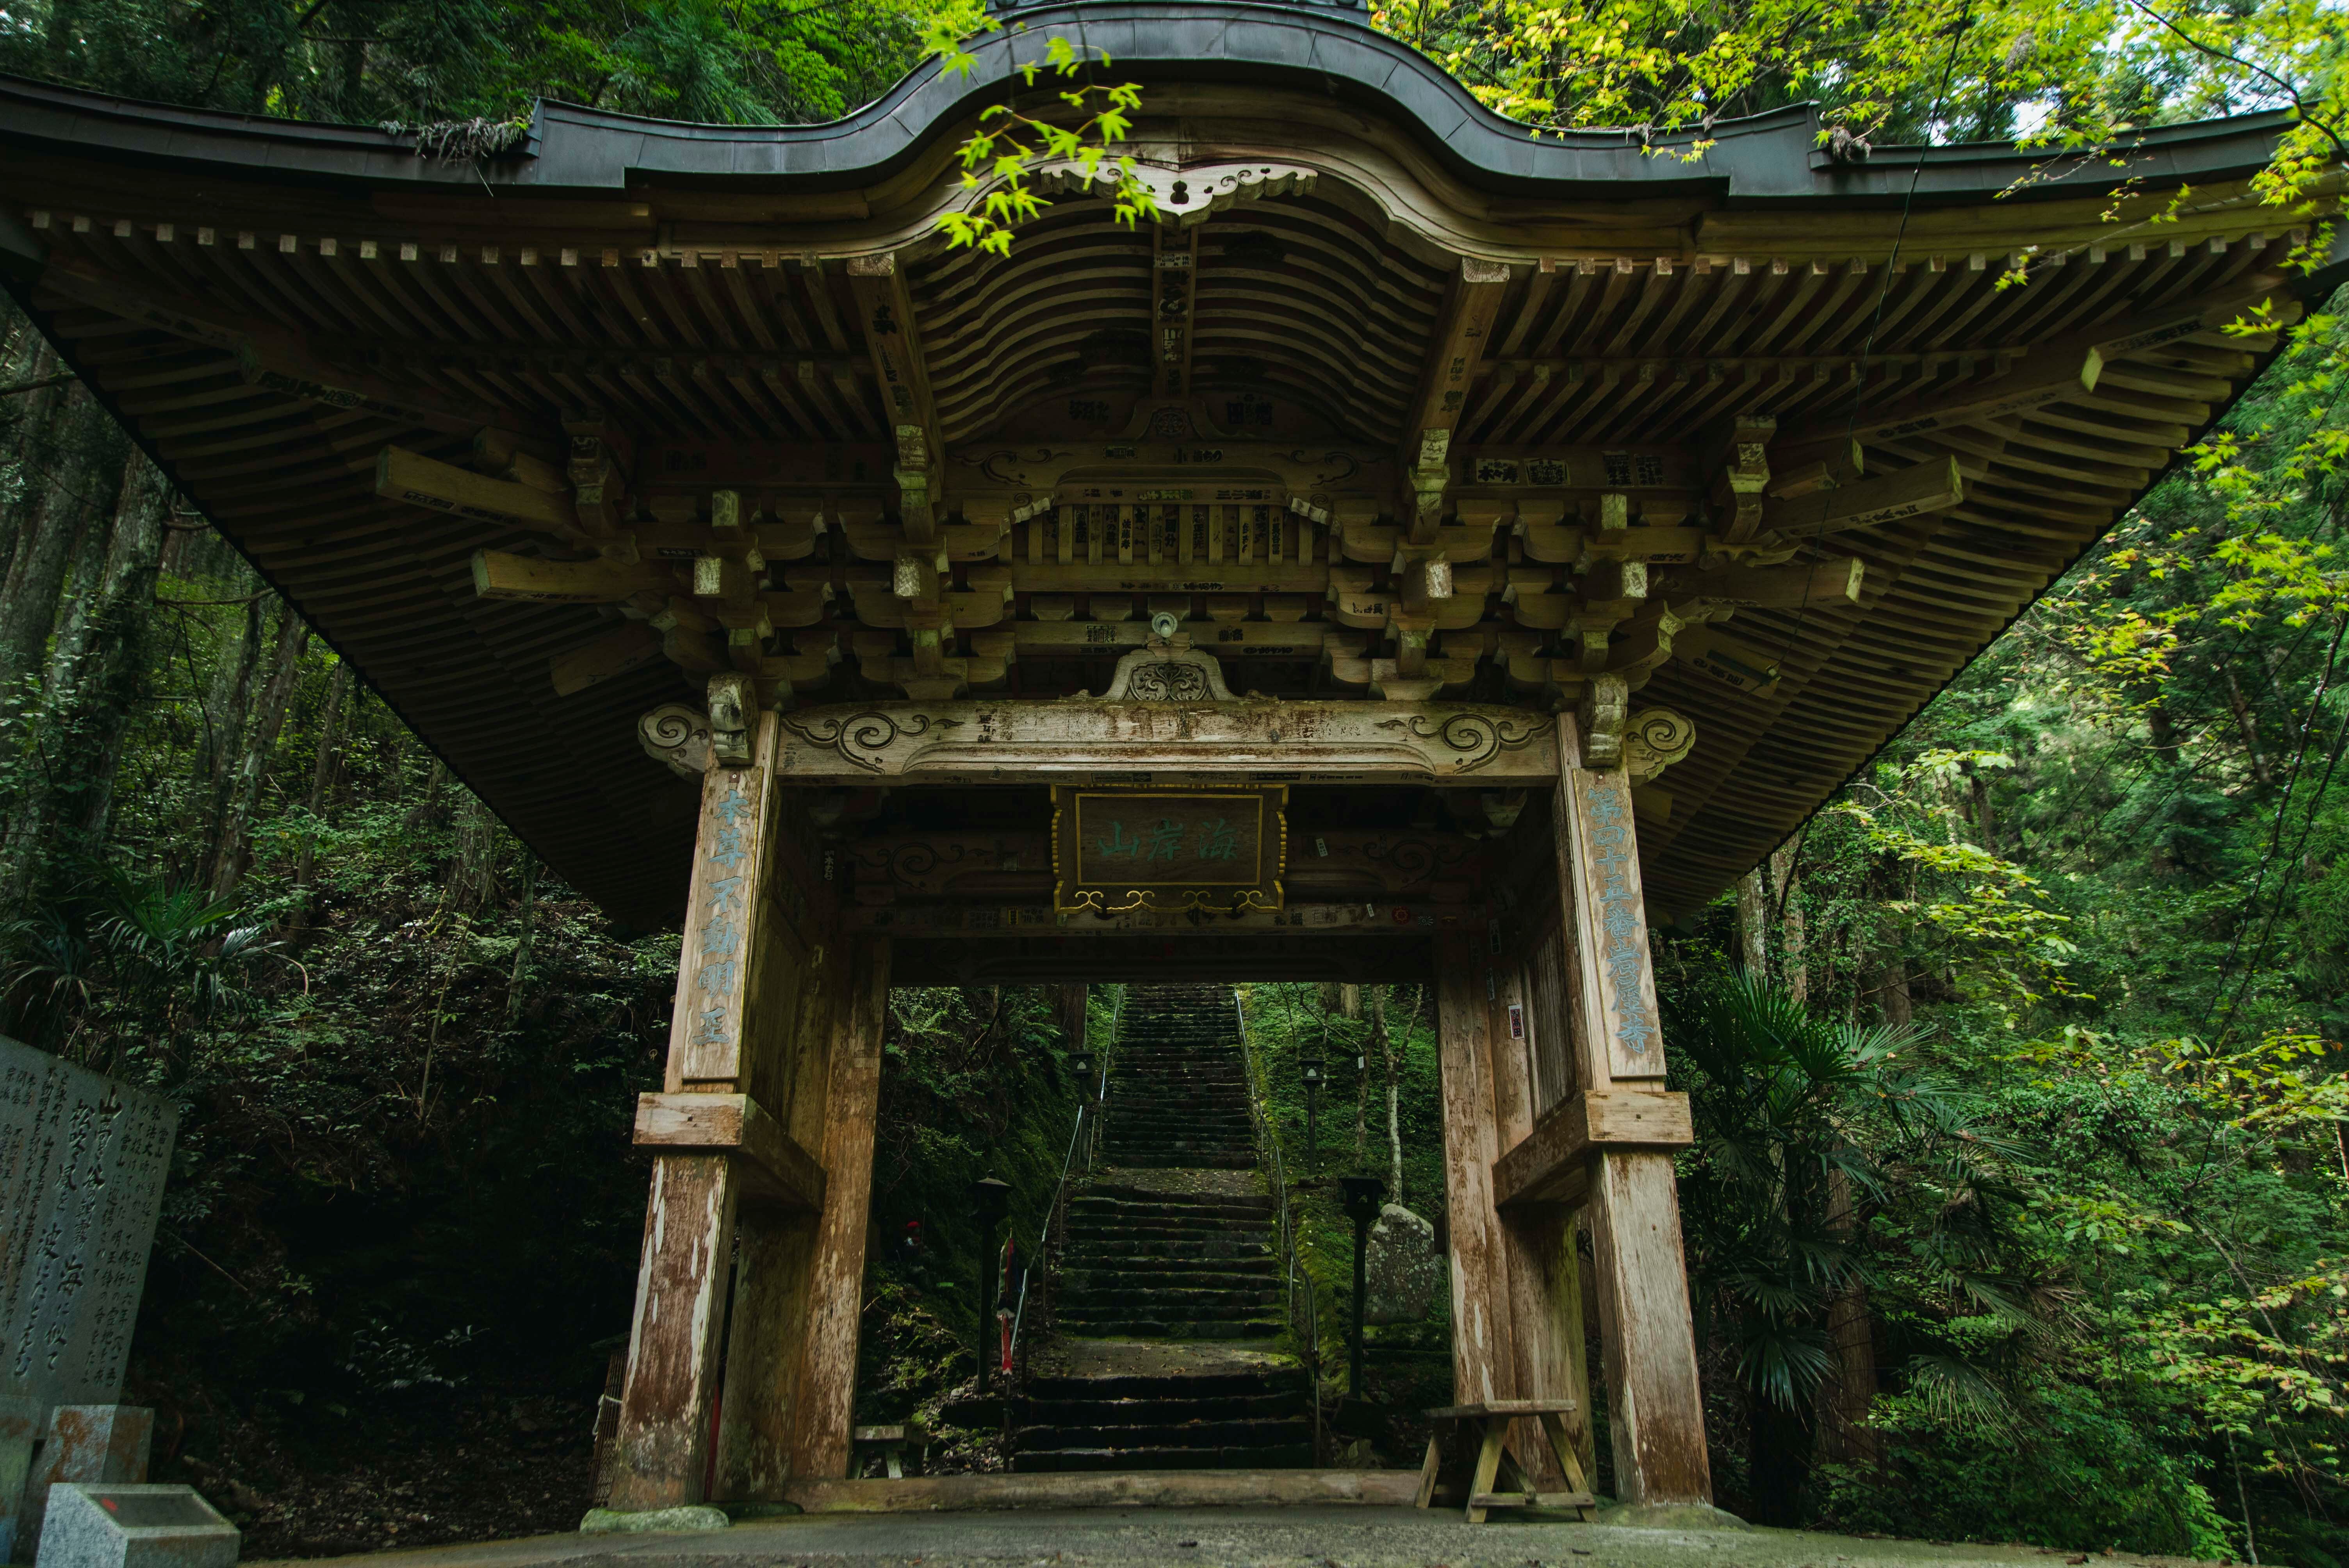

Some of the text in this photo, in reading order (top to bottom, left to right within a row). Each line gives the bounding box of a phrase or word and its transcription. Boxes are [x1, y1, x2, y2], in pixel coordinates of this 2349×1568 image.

[693, 789, 750, 1046] 本尊不動明王
[1587, 788, 1654, 1054] 第四十五番岩屋寺
